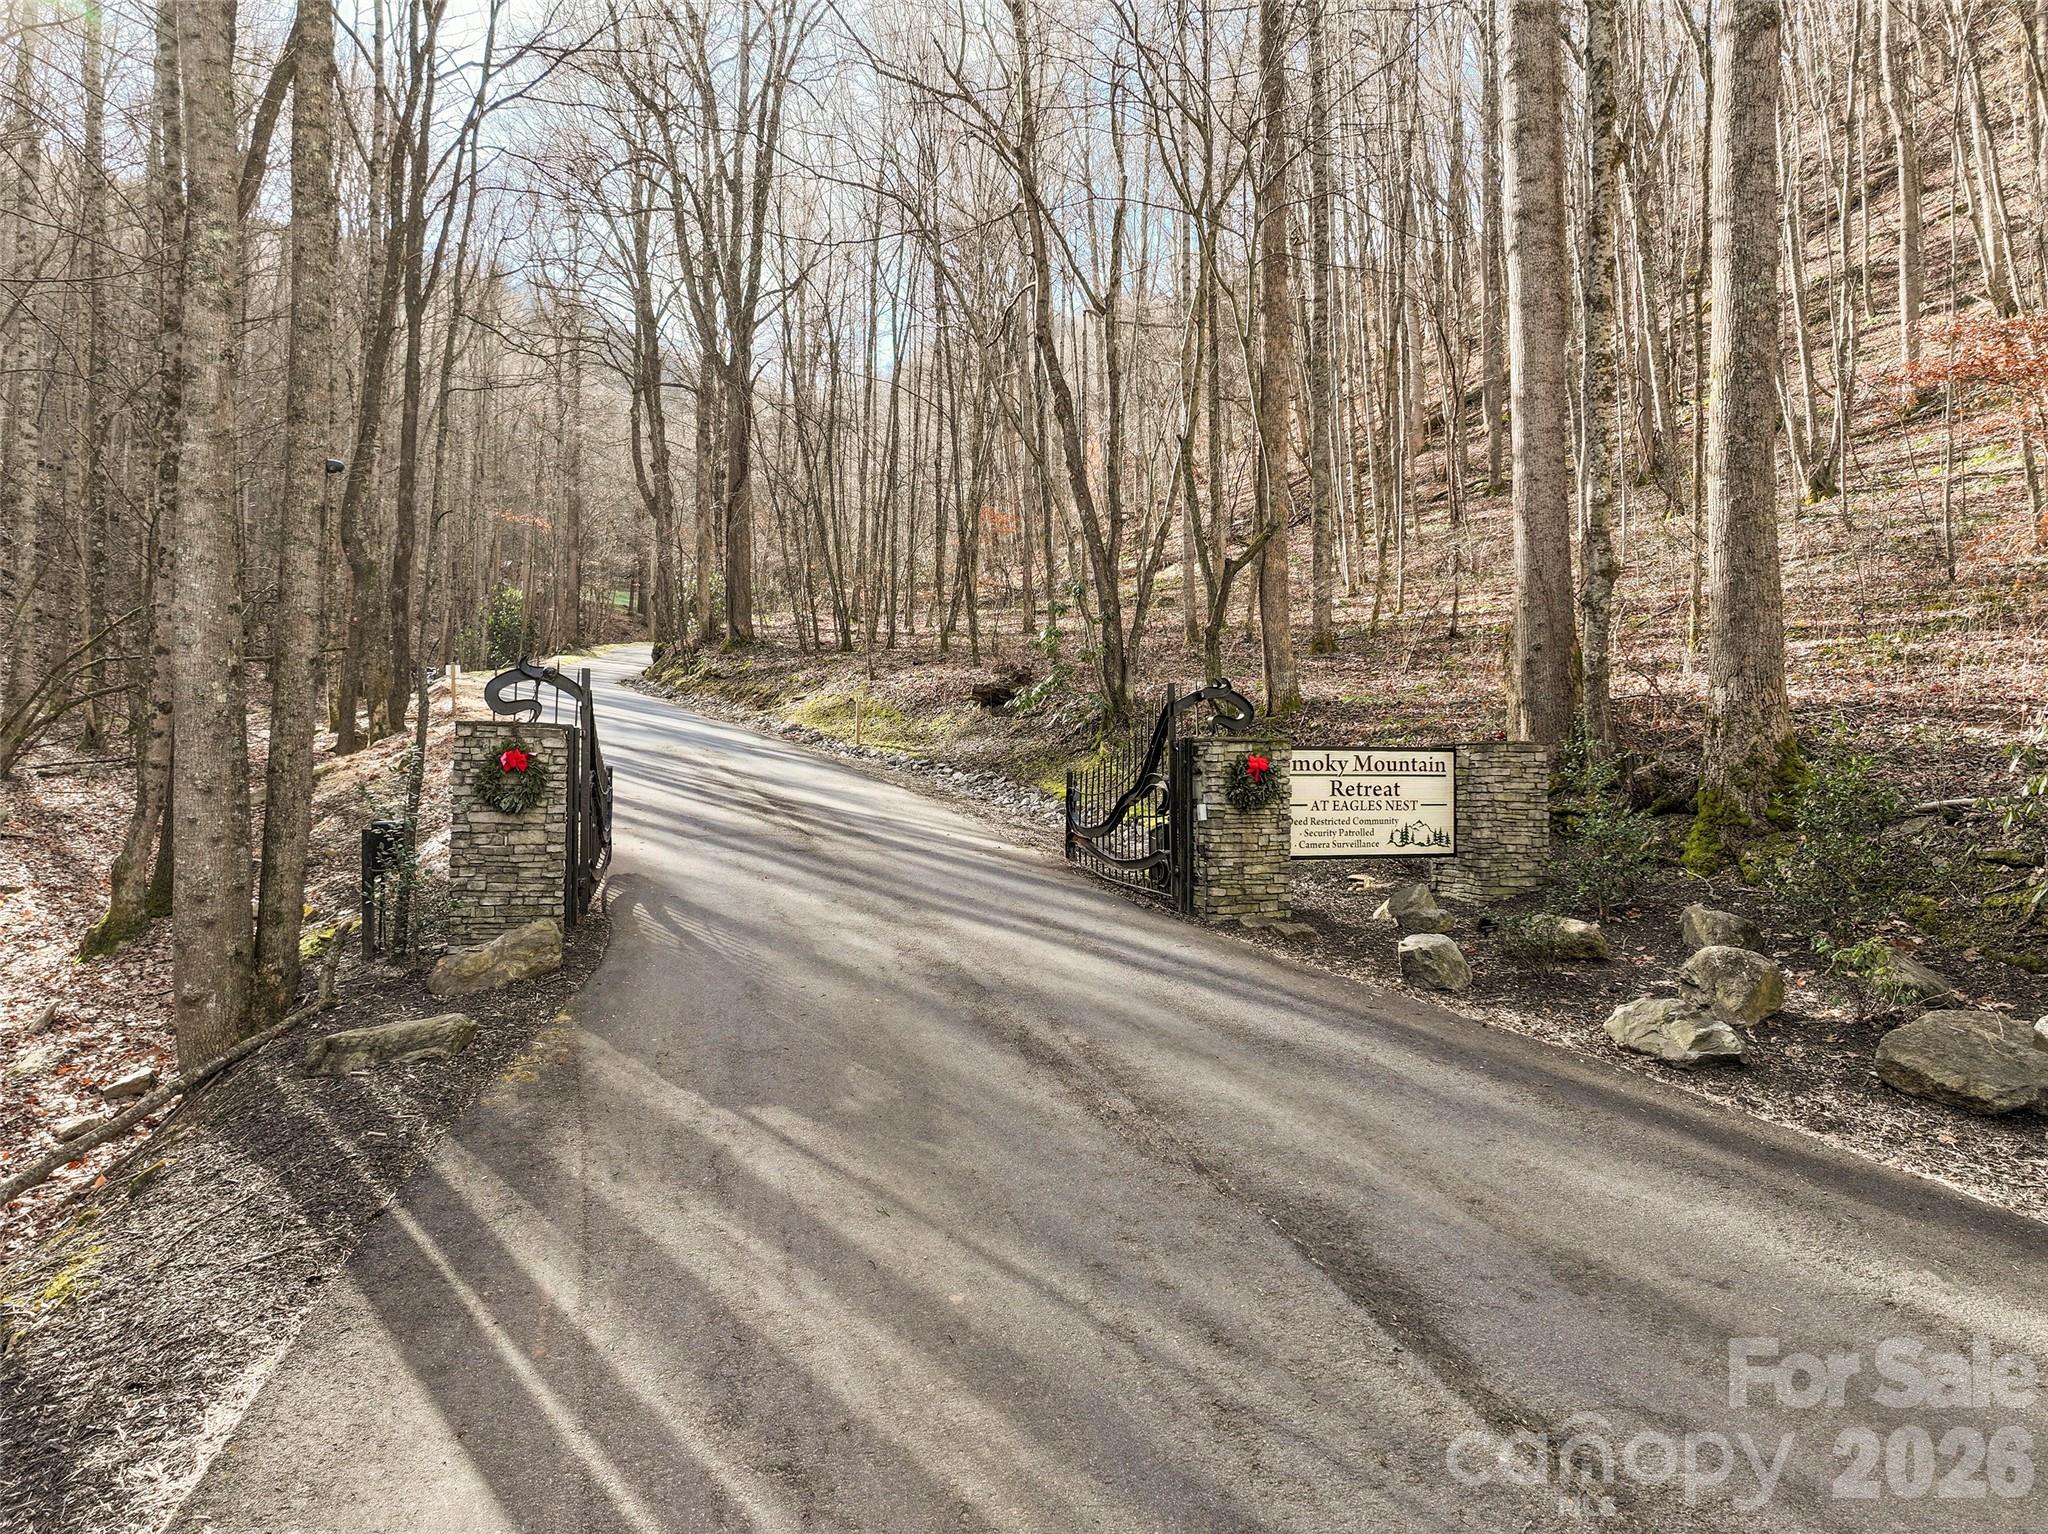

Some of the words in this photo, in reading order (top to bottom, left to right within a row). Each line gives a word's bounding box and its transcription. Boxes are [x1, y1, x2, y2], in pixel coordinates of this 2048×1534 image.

[1291, 753, 1349, 777] moky
[1353, 754, 1446, 773] Mountain
[1330, 780, 1401, 797] Retreat
[1310, 801, 1329, 812] AT
[1333, 800, 1383, 812] EAGLES
[1386, 800, 1418, 811] NEST
[1310, 817, 1350, 826] Restricted
[1352, 817, 1399, 828] Community
[1304, 829, 1337, 840] Security
[1339, 828, 1375, 837] Patrolled
[1299, 841, 1330, 849] Camera
[1332, 840, 1380, 849] Surveillance
